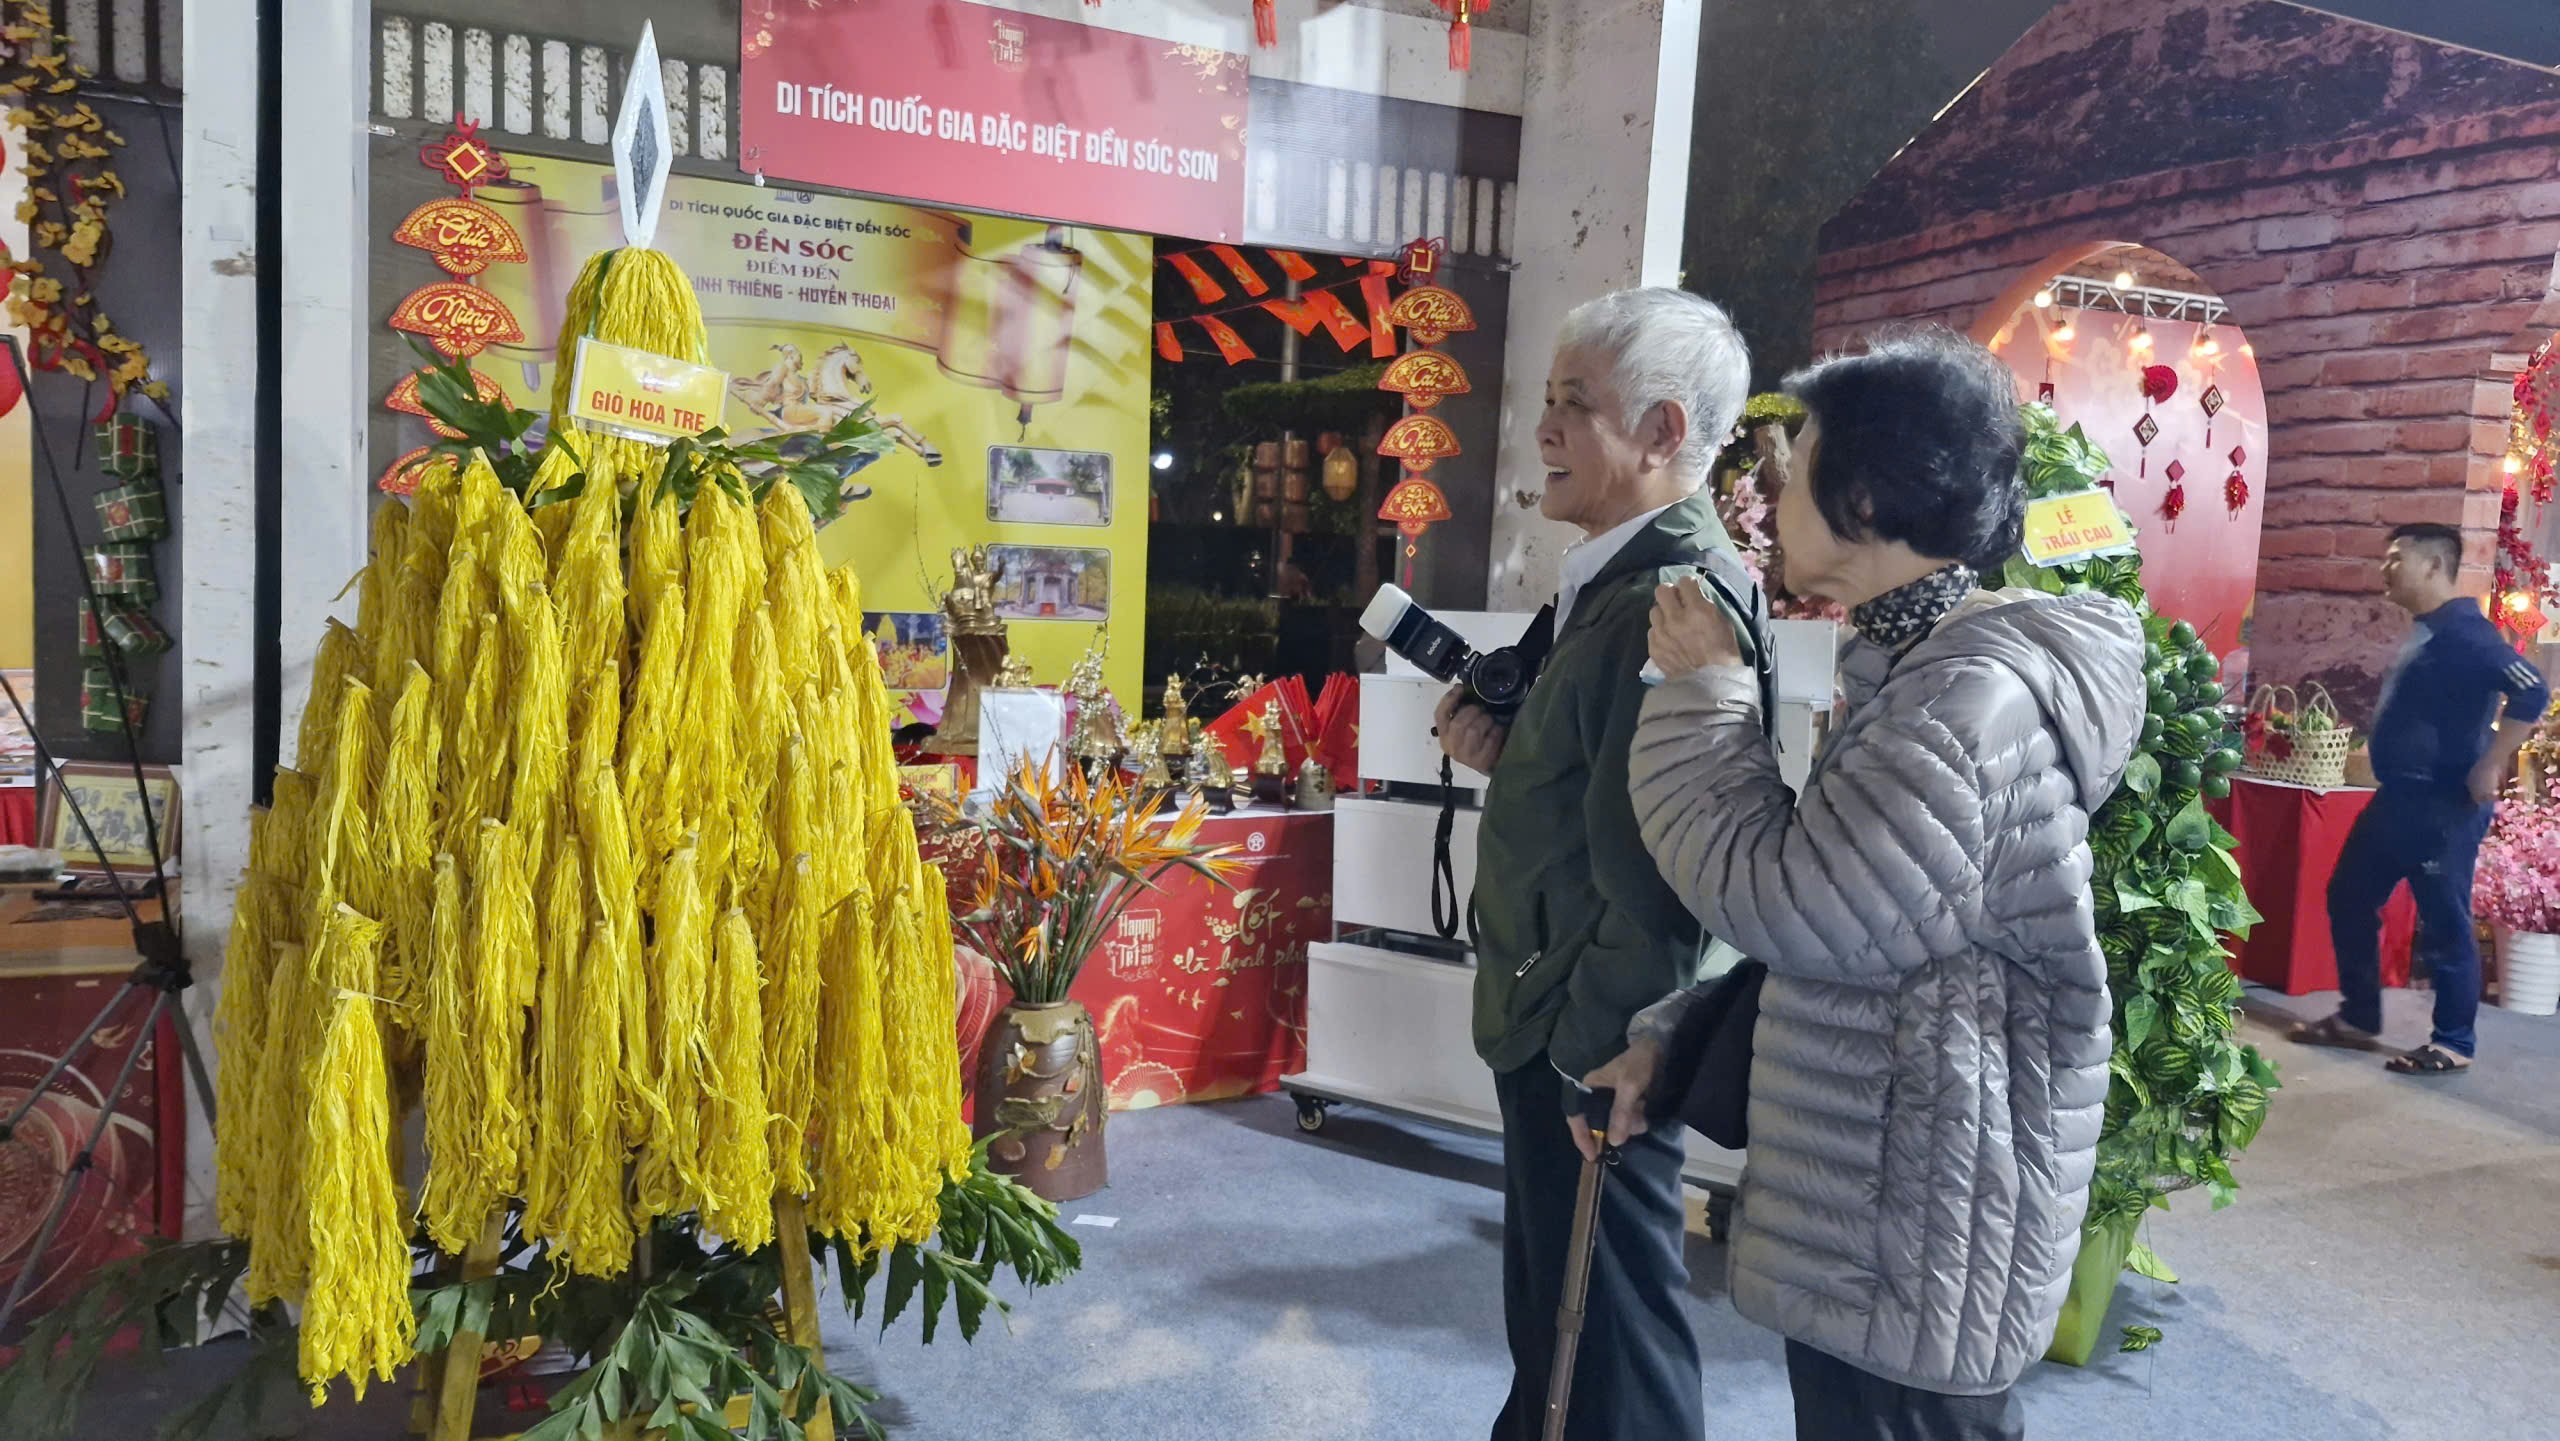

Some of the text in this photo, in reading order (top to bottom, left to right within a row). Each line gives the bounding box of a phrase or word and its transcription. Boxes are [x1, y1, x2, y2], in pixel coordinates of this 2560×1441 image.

[776, 80, 1219, 183] DI TÍCH QUỐC GIA ĐẶC BIỆT ĐỀN SÓC SƠN
[669, 199, 684, 211] DI
[687, 200, 719, 215] TÍCH
[723, 204, 763, 221] QUỐC
[767, 211, 790, 224] GIA
[793, 213, 821, 230] ĐẶC
[825, 217, 852, 233] BIỆT
[884, 223, 912, 238] SÓC
[799, 238, 854, 262] SÓC
[691, 275, 722, 294] INH
[727, 278, 783, 300] THIÊNG
[851, 292, 896, 313] THOẠI
[591, 389, 706, 433] GIÒ HOA TRE
[2082, 524, 2113, 543] CAU
[1272, 940, 1308, 991] phú
